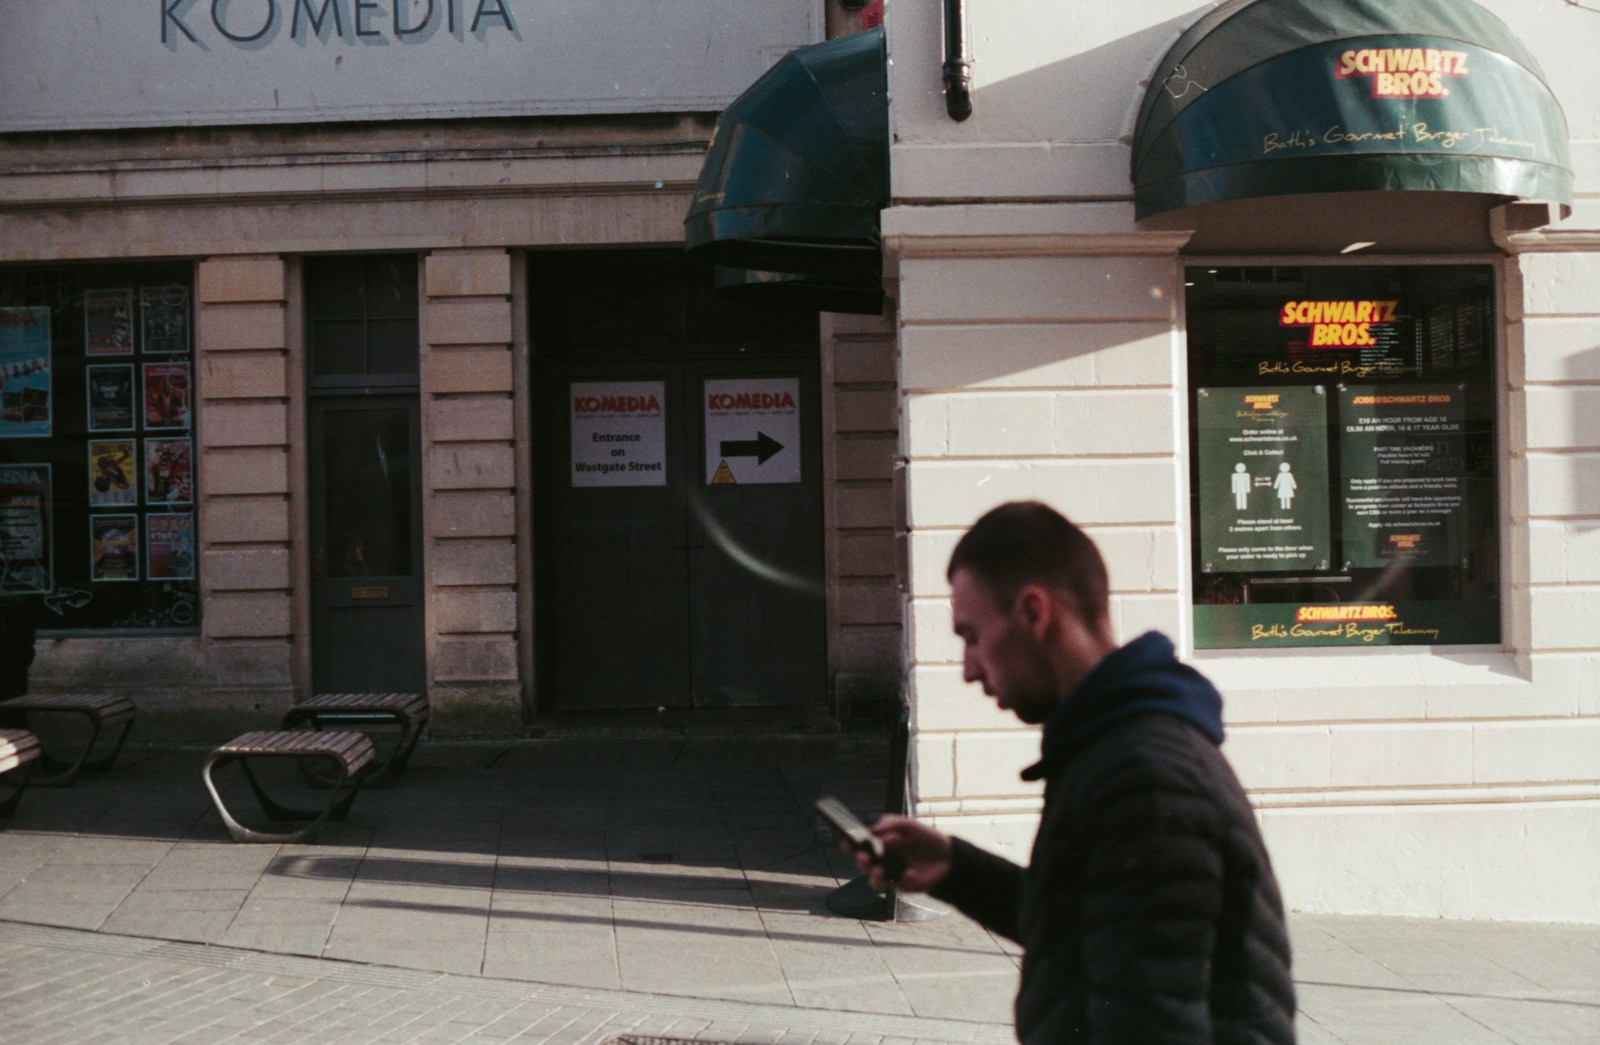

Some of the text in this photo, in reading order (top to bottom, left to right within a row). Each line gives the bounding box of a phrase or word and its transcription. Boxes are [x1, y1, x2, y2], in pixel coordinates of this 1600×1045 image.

[161, 0, 509, 43] KOMEDIA
[1337, 48, 1468, 78] SCHWARTZ
[1374, 72, 1449, 98] BROS.
[1263, 130, 1316, 154] Bath's
[1323, 125, 1406, 143] Gourmet
[1413, 122, 1468, 148] Burger
[1281, 301, 1399, 325] SCHWARTZ
[1311, 323, 1376, 348] BROS.
[1258, 361, 1290, 376] Bath's
[1292, 361, 1338, 373] Gourmet
[1340, 361, 1376, 377] Burger
[575, 395, 661, 413] KOMEDIA
[708, 391, 796, 409] KOMEDIA
[592, 433, 641, 442] Entrance
[611, 449, 625, 457] on
[575, 461, 662, 474] Westgate Street
[1297, 606, 1361, 621] SCHWARTZ
[1252, 624, 1288, 640] Bath's
[1290, 624, 1343, 637] Gourmet
[1345, 623, 1385, 641] Burger
